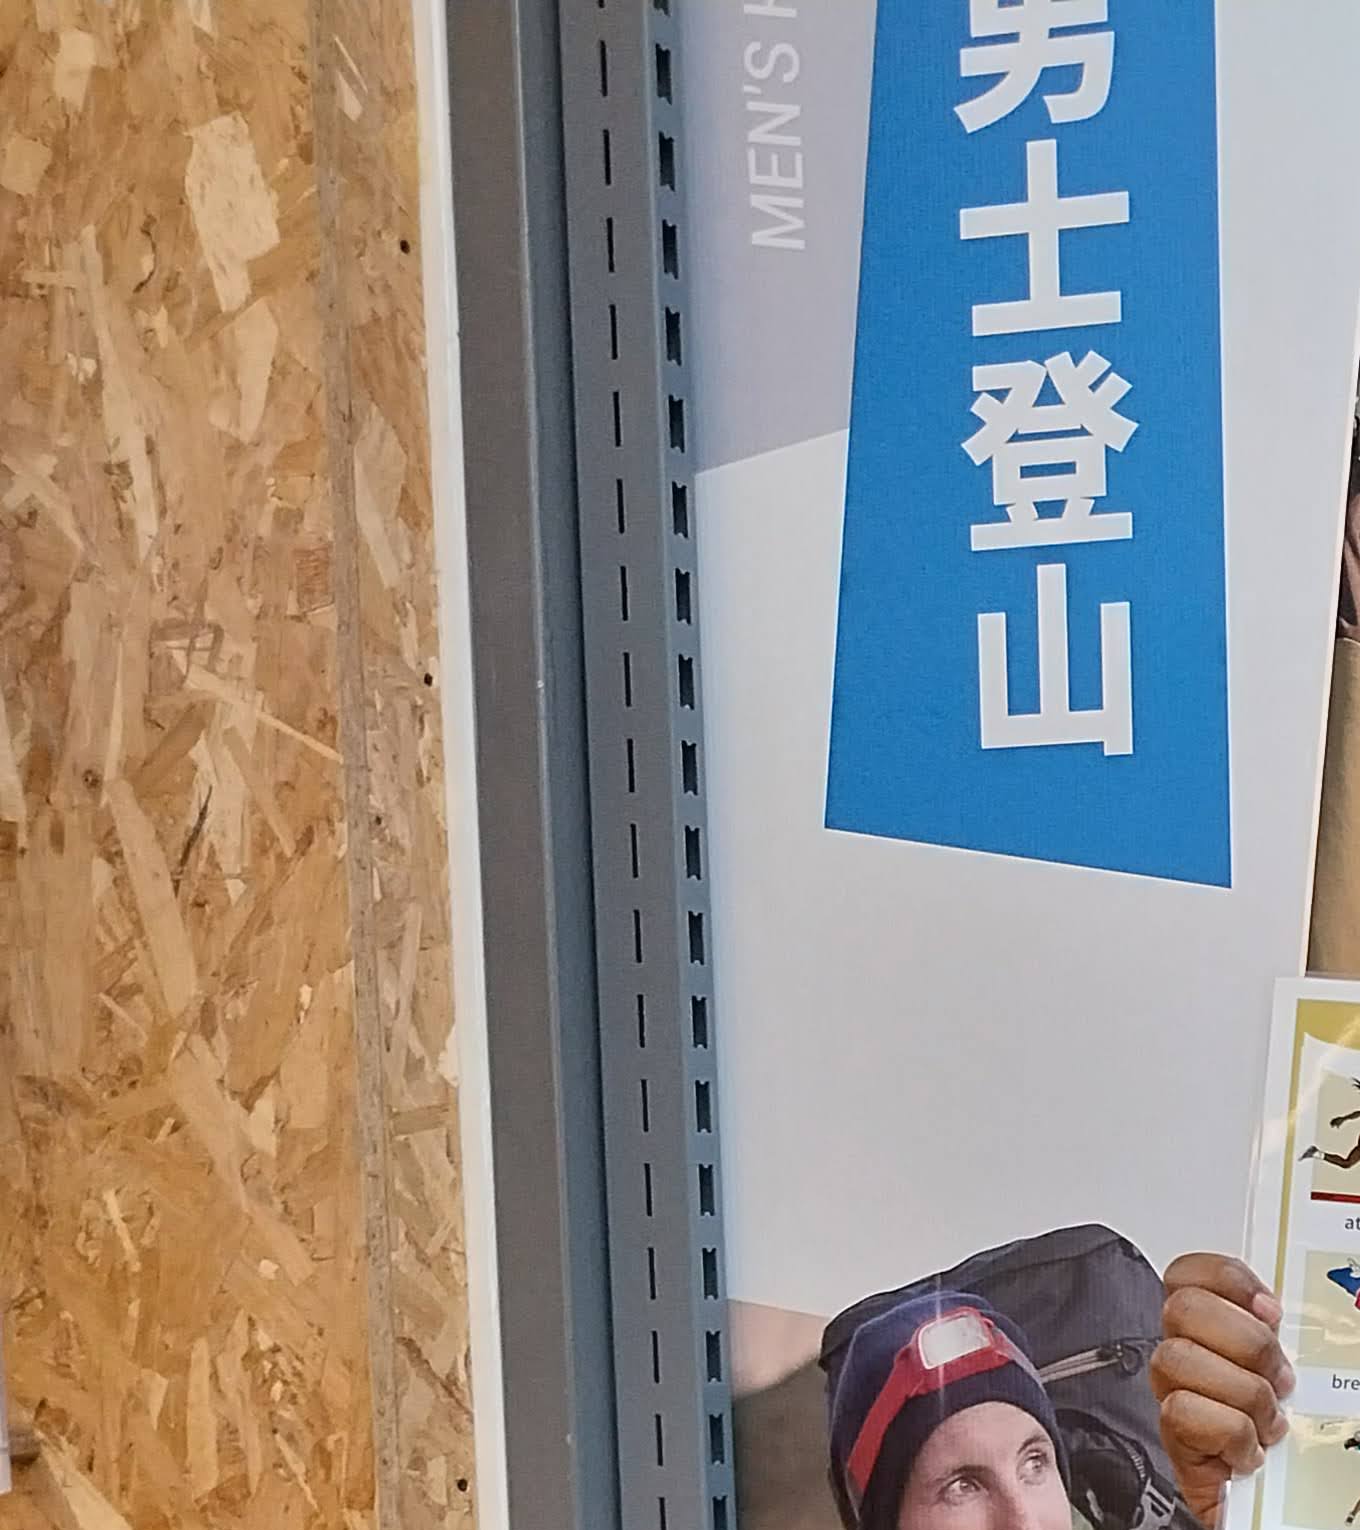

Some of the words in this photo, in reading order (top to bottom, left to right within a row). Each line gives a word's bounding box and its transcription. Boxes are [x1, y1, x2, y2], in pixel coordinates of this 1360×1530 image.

[743, 41, 805, 250] MEN'S
[953, 0, 1140, 757] 男士登山
